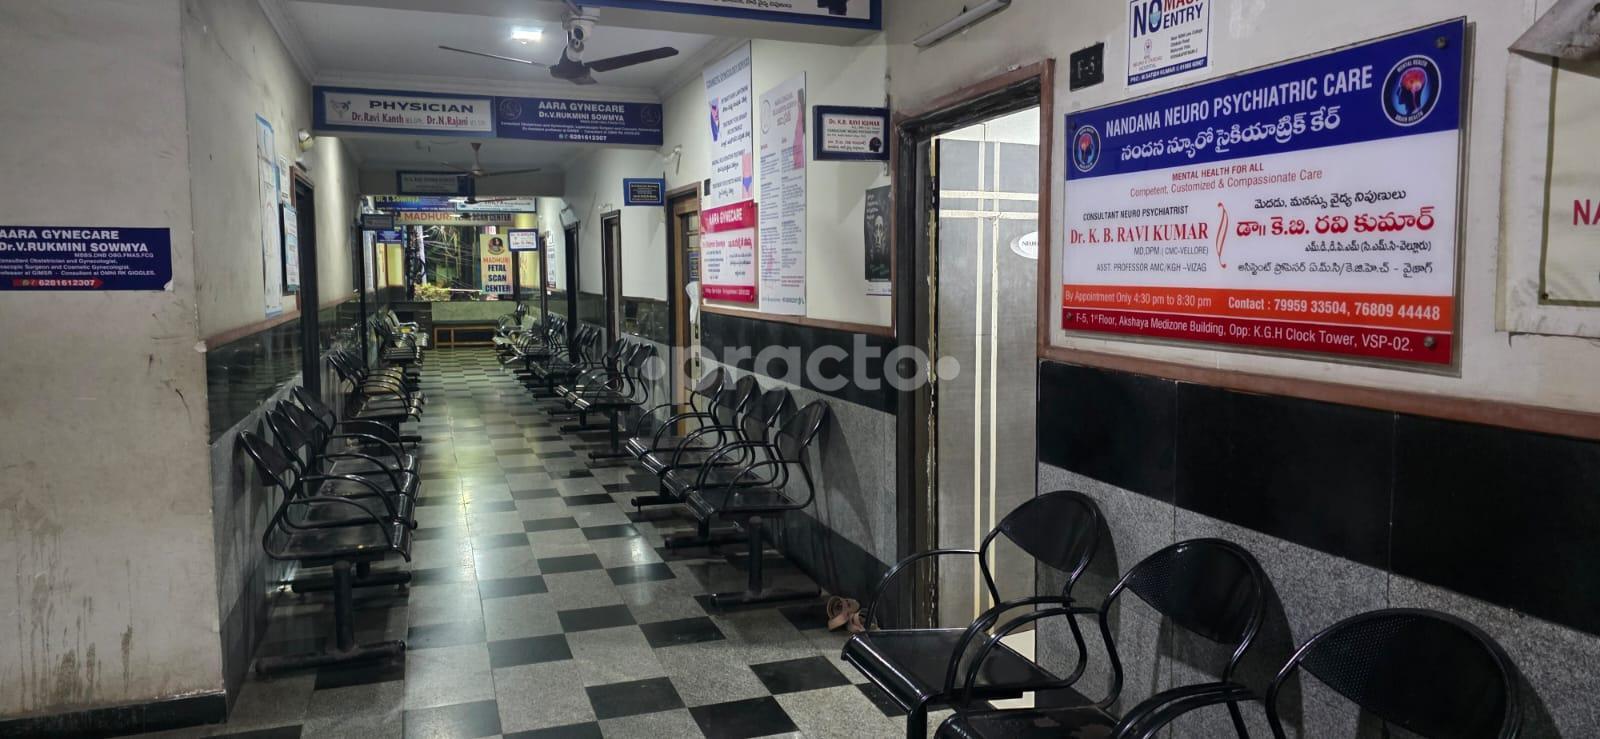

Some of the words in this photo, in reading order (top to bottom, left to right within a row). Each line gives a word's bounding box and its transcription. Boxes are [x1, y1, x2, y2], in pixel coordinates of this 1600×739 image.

[1133, 0, 1162, 37] NO
[1163, 3, 1204, 29] ENTRY
[369, 100, 474, 113] PHYSICIAN
[538, 101, 567, 110] AARA
[570, 102, 625, 113] GYNECARE
[1105, 111, 1161, 138] NANDANA
[1164, 100, 1209, 127] NEURO
[1213, 77, 1317, 117] PSYCHIATRIC
[1323, 65, 1373, 97] CARE
[352, 111, 380, 122] Dr.Ravi
[382, 112, 404, 123] Kanth
[538, 111, 589, 121] Dr.V.RUKMINI
[591, 113, 624, 122] SOWMYA
[1121, 138, 1164, 161] నందన
[1310, 105, 1341, 132] కేర్
[1172, 171, 1199, 181] MENTAL
[1201, 167, 1230, 178] HEALTH
[1232, 165, 1247, 175] FOR
[1249, 163, 1264, 172] ALL
[1171, 180, 1216, 194] Customized
[1218, 179, 1225, 188] &
[1227, 173, 1297, 188] Compassionate
[1299, 169, 1323, 180] Care
[1329, 194, 1352, 207] వైద్య
[1354, 189, 1407, 204] నిపుణులు
[1083, 210, 1119, 222] CONSULTANT
[1120, 209, 1140, 219] NEURO
[1142, 205, 1189, 217] PSYCHIATRIST
[1315, 213, 1349, 234] రవి
[1353, 206, 1435, 233] కుమార్
[0, 229, 37, 239] AARA
[41, 230, 120, 240] GYNECARE
[1070, 229, 1086, 244] Dr.
[1088, 228, 1100, 243] K.
[1103, 227, 1114, 243] B.
[1117, 225, 1149, 242] RAVI
[1153, 222, 1209, 242] KUMAR
[0, 242, 86, 252] Dr.V.RUKMINI
[90, 242, 148, 252] SOWMYA
[488, 264, 506, 272] FETAL
[1096, 263, 1112, 272] ASST.
[1113, 263, 1148, 272] PROFESSOR
[38, 279, 96, 287] 6281612307
[488, 274, 507, 282] SCAN
[485, 284, 511, 292] CENTER
[1065, 290, 1073, 301] By
[1075, 290, 1115, 303] Appointment
[1116, 292, 1132, 303] Only
[1133, 293, 1150, 304] 4:30
[1152, 296, 1165, 307] pm
[1166, 296, 1175, 305] to
[1176, 294, 1195, 306] 8:30
[1197, 297, 1212, 308] pm
[1228, 296, 1265, 310] Contact
[1274, 298, 1307, 312] 79959
[1310, 300, 1351, 316] 33504,
[1354, 302, 1393, 317] 76809
[1397, 305, 1441, 320] 44448
[1076, 312, 1089, 324] F-5,
[1099, 314, 1117, 327] Floor,
[1118, 315, 1149, 329] Akshaya
[1150, 317, 1188, 331] Medizone
[1190, 320, 1226, 336] Building,
[1229, 323, 1251, 338] Opp:
[1253, 326, 1284, 340] K.G.H
[1285, 327, 1316, 343] Clock
[1318, 330, 1358, 347] Tower,
[1361, 334, 1414, 352] VSP-02.
